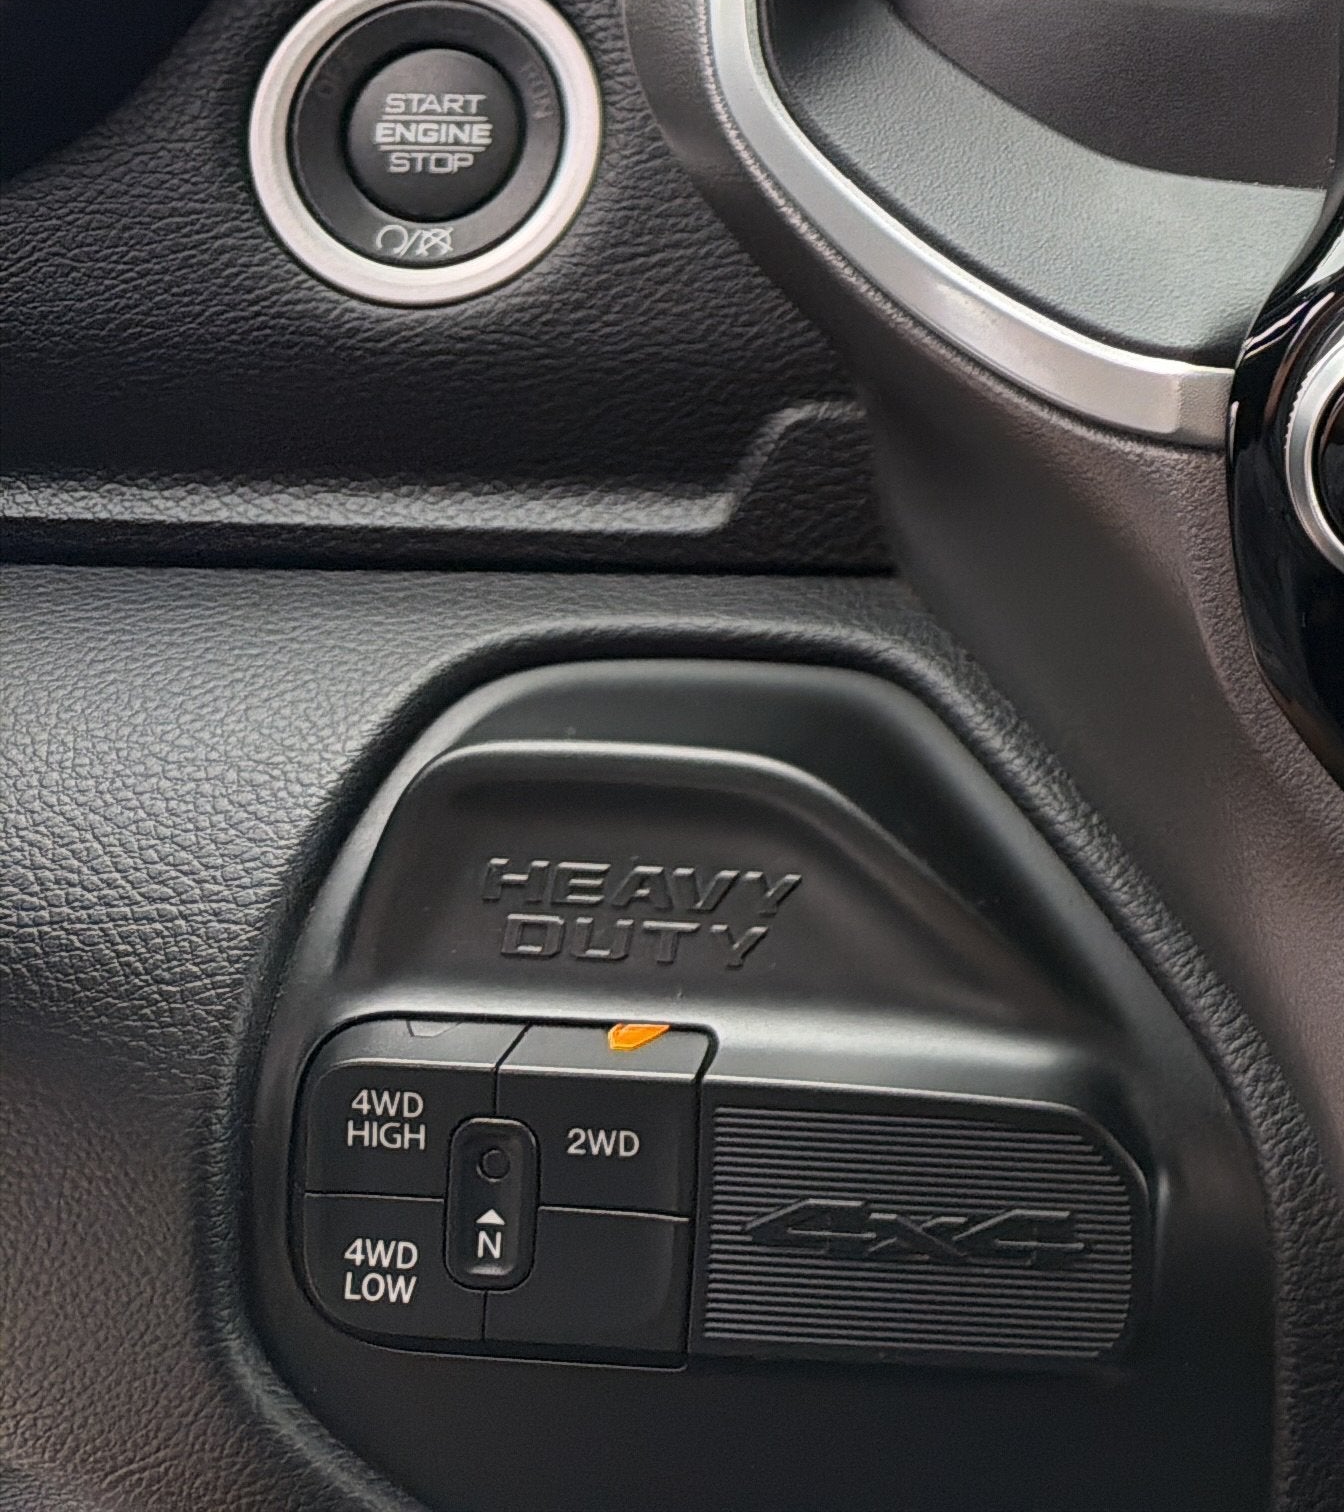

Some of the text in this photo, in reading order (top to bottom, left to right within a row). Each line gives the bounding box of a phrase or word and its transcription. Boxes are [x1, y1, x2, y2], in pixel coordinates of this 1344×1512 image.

[384, 93, 487, 115] START
[374, 122, 493, 145] ENGINE
[388, 152, 474, 174] STOP
[482, 857, 802, 915] HEAVY
[501, 912, 769, 968] DUTY
[351, 1089, 425, 1119] 4WD
[346, 1120, 427, 1151] HIGH
[566, 1127, 641, 1158] 2WD
[343, 1238, 419, 1270] 4WD
[476, 1230, 503, 1260] N
[344, 1271, 418, 1304] LOW
